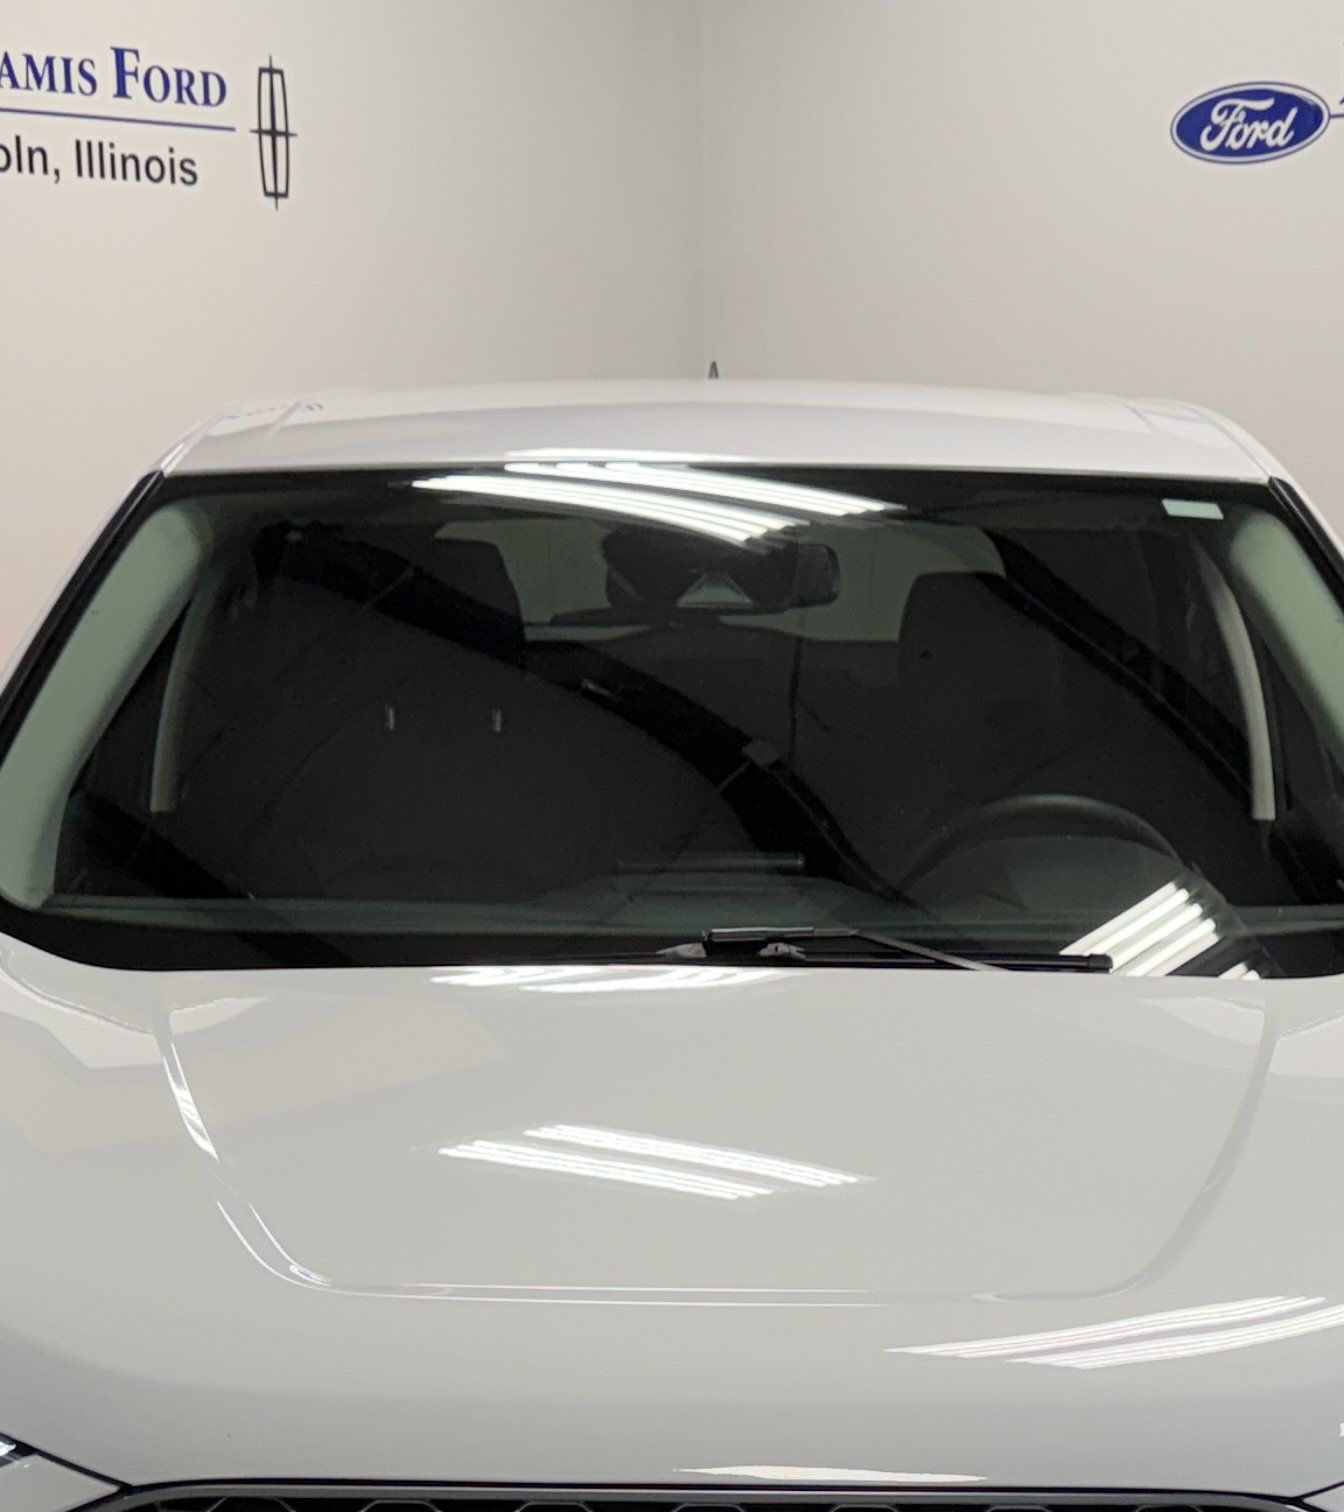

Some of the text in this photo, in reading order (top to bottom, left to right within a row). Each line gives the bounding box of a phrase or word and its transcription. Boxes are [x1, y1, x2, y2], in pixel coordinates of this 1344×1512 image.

[109, 46, 228, 108] FORD
[1200, 98, 1295, 152] Ford
[75, 139, 199, 186] Illinois
